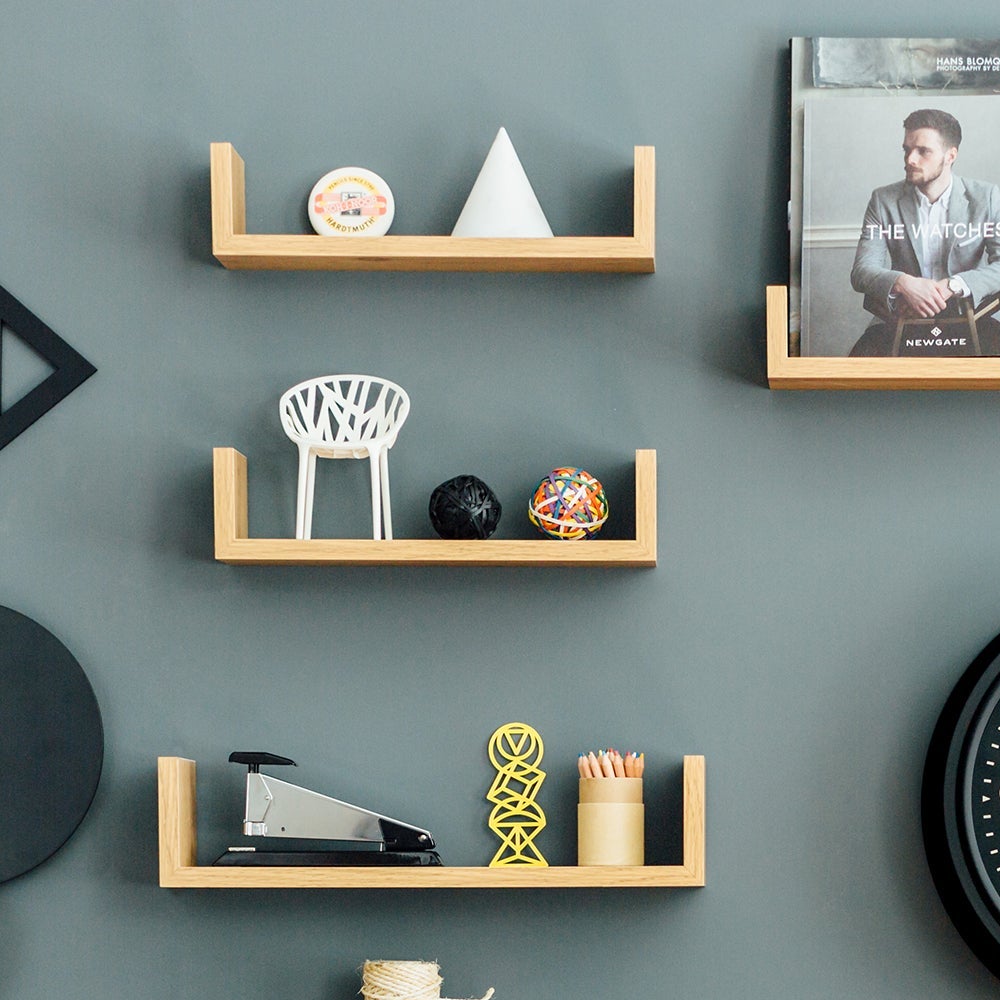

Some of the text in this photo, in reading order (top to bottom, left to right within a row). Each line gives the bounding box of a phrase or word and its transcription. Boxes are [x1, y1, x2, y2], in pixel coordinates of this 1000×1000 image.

[936, 57, 964, 66] HANS
[866, 224, 905, 240] THE
[906, 338, 967, 347] NEWGATE
